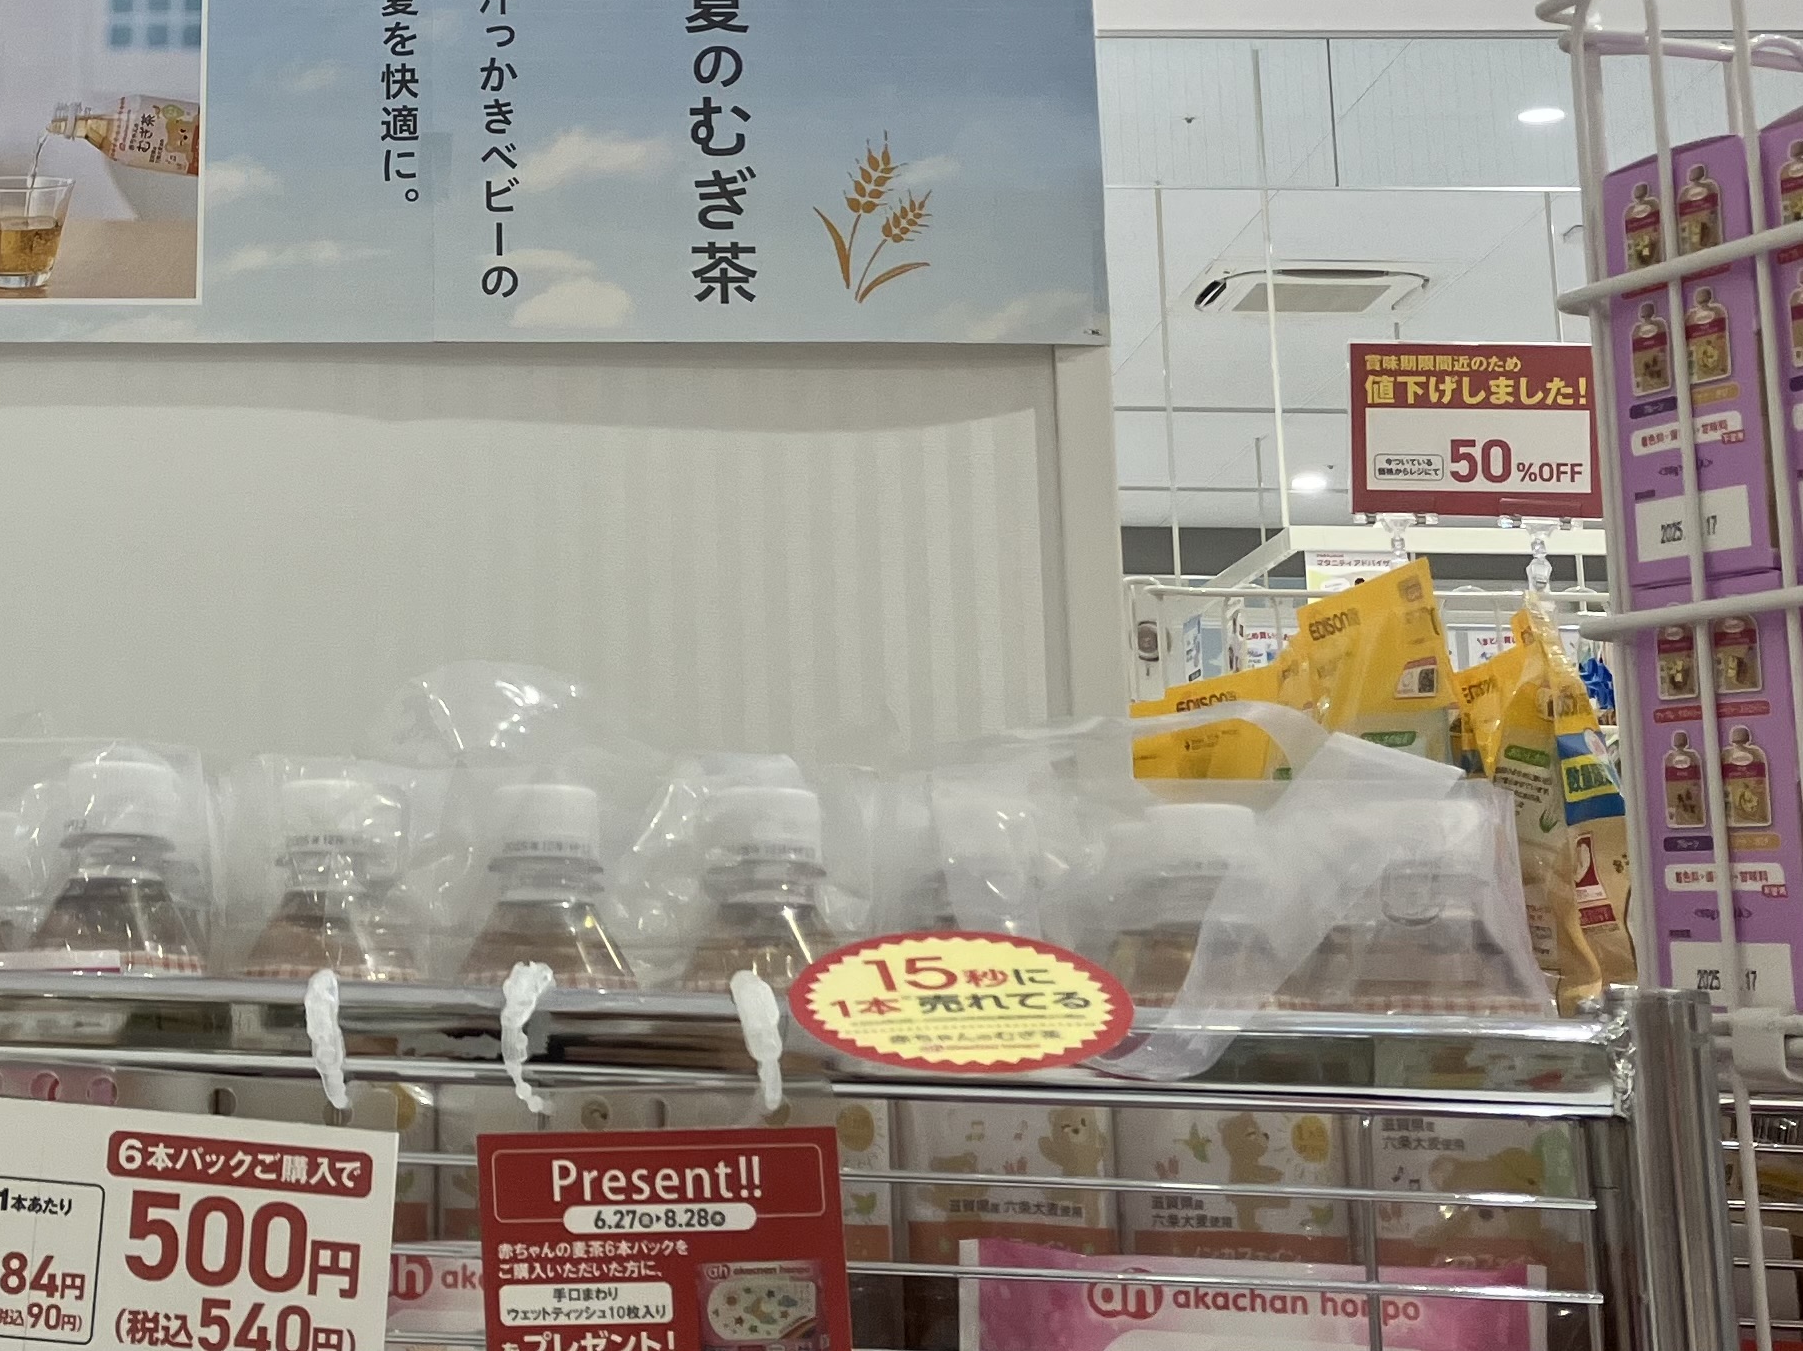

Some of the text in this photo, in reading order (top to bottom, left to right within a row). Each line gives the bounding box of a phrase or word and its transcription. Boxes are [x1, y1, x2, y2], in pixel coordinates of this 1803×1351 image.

[1365, 355, 1522, 372] 賞味期限間近のため
[1365, 375, 1587, 406] 値下げしました!
[864, 956, 1056, 993] 15秒に
[918, 991, 1091, 1015] 売れてる
[118, 1145, 362, 1191] 6本パックご購入で
[551, 1155, 762, 1203] Present!!
[124, 1189, 361, 1301] 500円
[498, 1240, 688, 1260] 赤ちゃんの麦茶6本パックを
[0, 1251, 86, 1301] 84円
[498, 1260, 663, 1280] ご購入いただいた方に、
[553, 1287, 618, 1302] 手口まわり
[1173, 1288, 1308, 1315] akachan
[507, 1305, 666, 1322] ウェットティッシュ10枚入り
